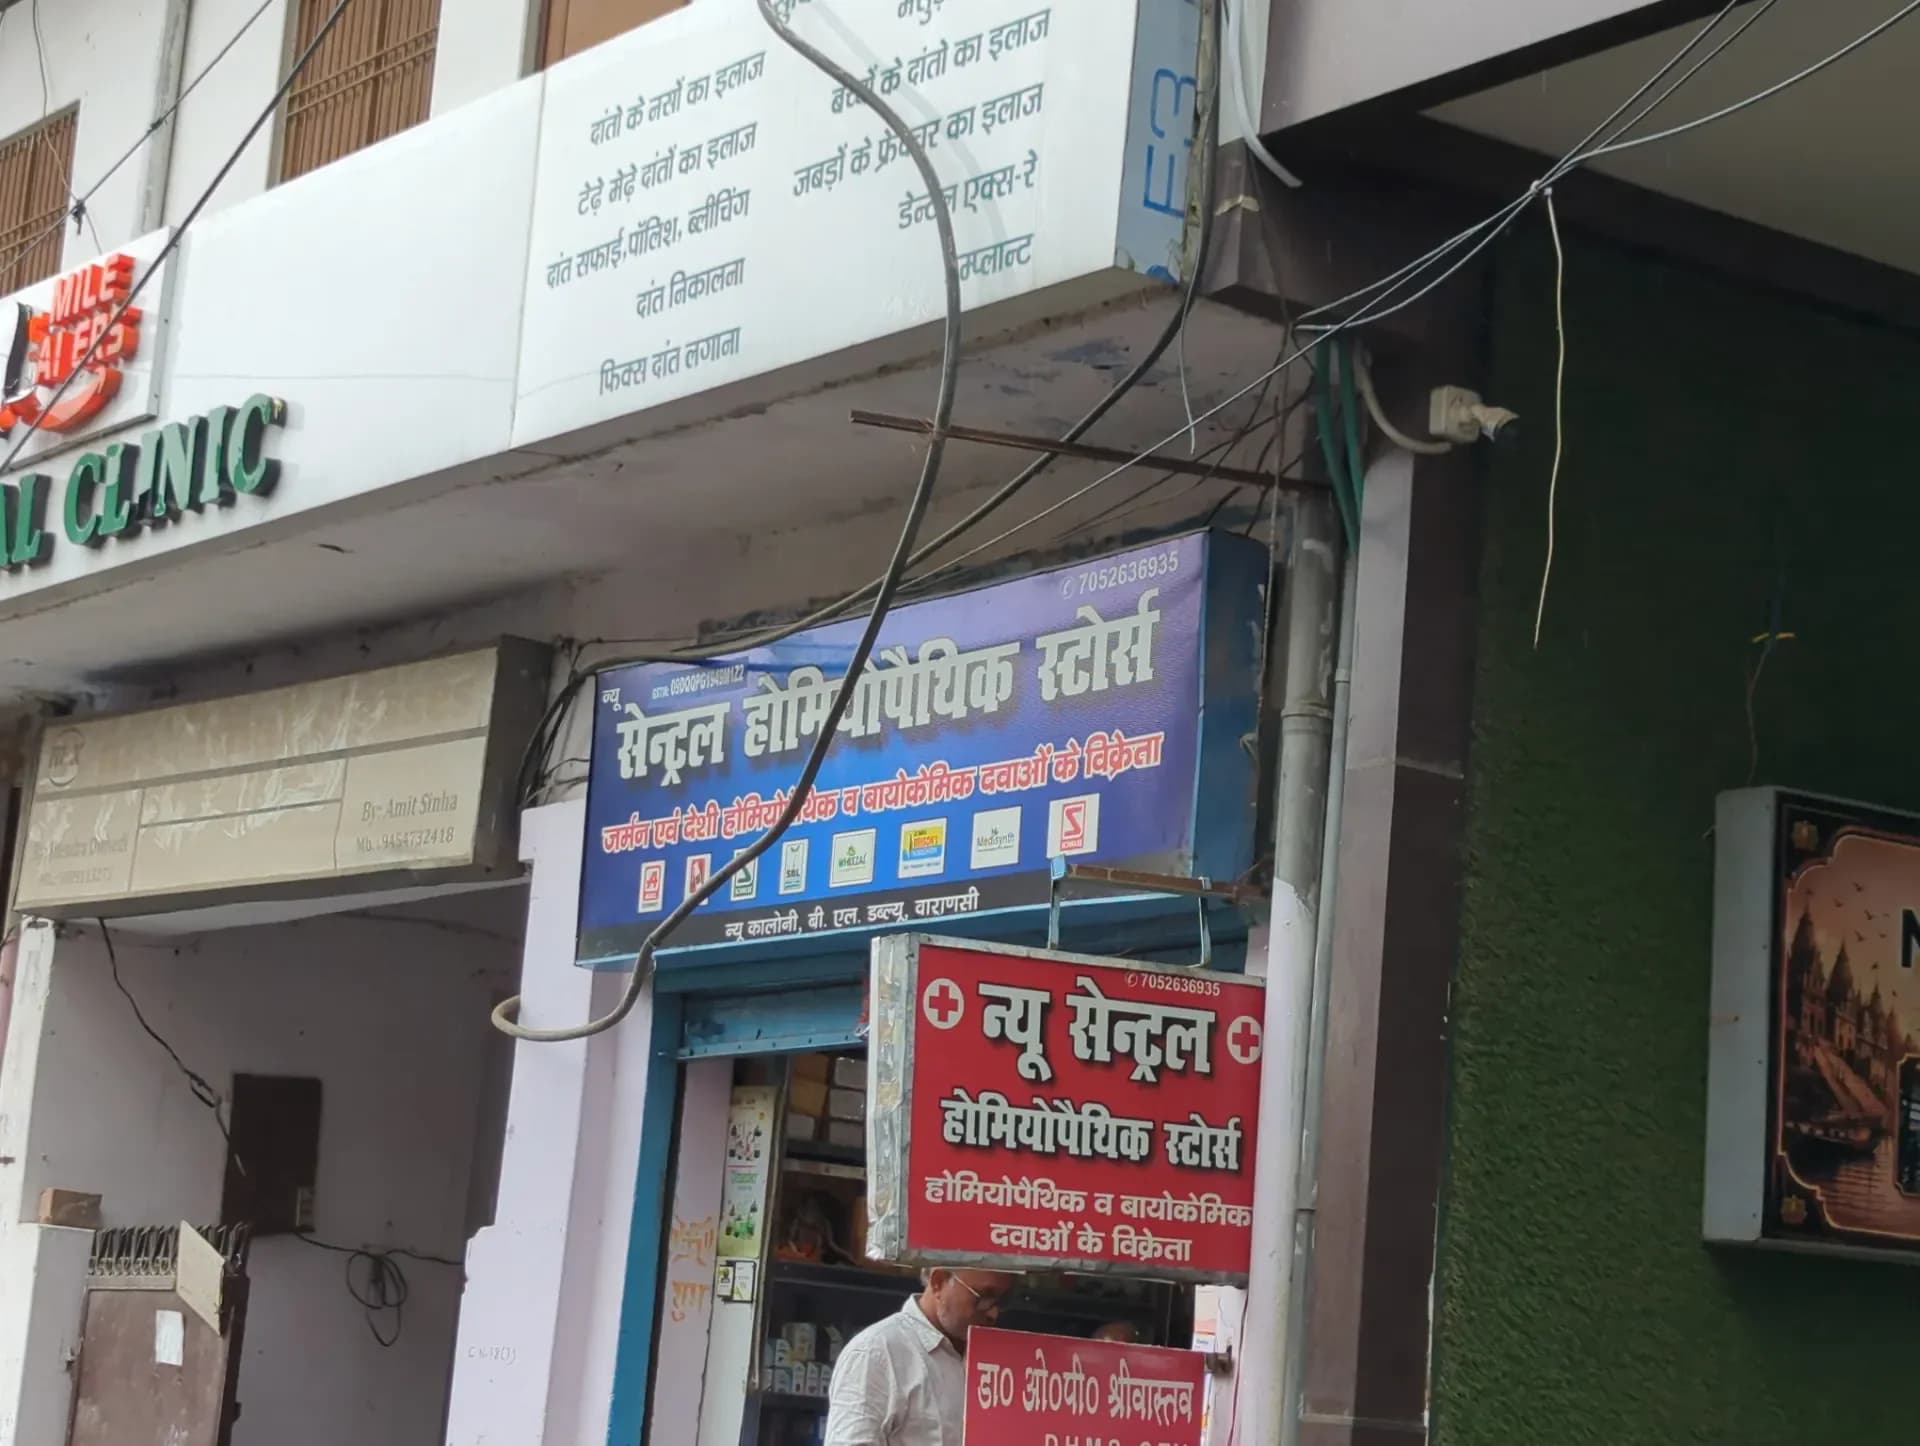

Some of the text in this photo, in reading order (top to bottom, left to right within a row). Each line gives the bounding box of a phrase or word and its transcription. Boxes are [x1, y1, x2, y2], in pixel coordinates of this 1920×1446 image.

[879, 57, 903, 95] के
[953, 32, 983, 67] का
[988, 8, 1052, 62] इलाज
[626, 95, 645, 130] के
[686, 74, 710, 105] का
[715, 51, 766, 98] इलाज
[678, 143, 703, 174] का
[707, 122, 758, 169] इलाज
[849, 136, 872, 176] के
[946, 106, 976, 140] का
[981, 82, 1044, 135] इलाज
[546, 252, 572, 288] दांत
[636, 257, 746, 319] दांत निकालना
[599, 326, 742, 396] फिक्स दांत लगाना
[64, 392, 285, 549] CLINIC
[1079, 550, 1179, 594] 7052636935
[1035, 588, 1160, 701] स्टोर्स
[602, 812, 650, 853] जर्मन
[653, 805, 681, 848] एवं
[682, 799, 719, 841] देशी
[842, 786, 861, 816] व
[1052, 738, 1082, 782] के
[1083, 729, 1165, 783] विक्रेता
[915, 886, 981, 916] वाराणसी
[1140, 972, 1221, 997] 7052636935
[977, 974, 1216, 1084] न्यू सेन्ट्रल
[1163, 1112, 1242, 1172] स्टोर्स
[924, 1169, 1253, 1228] होमियोपैथिक व बायोकेमिक
[990, 1220, 1193, 1263] दवाओं के विक्रेता
